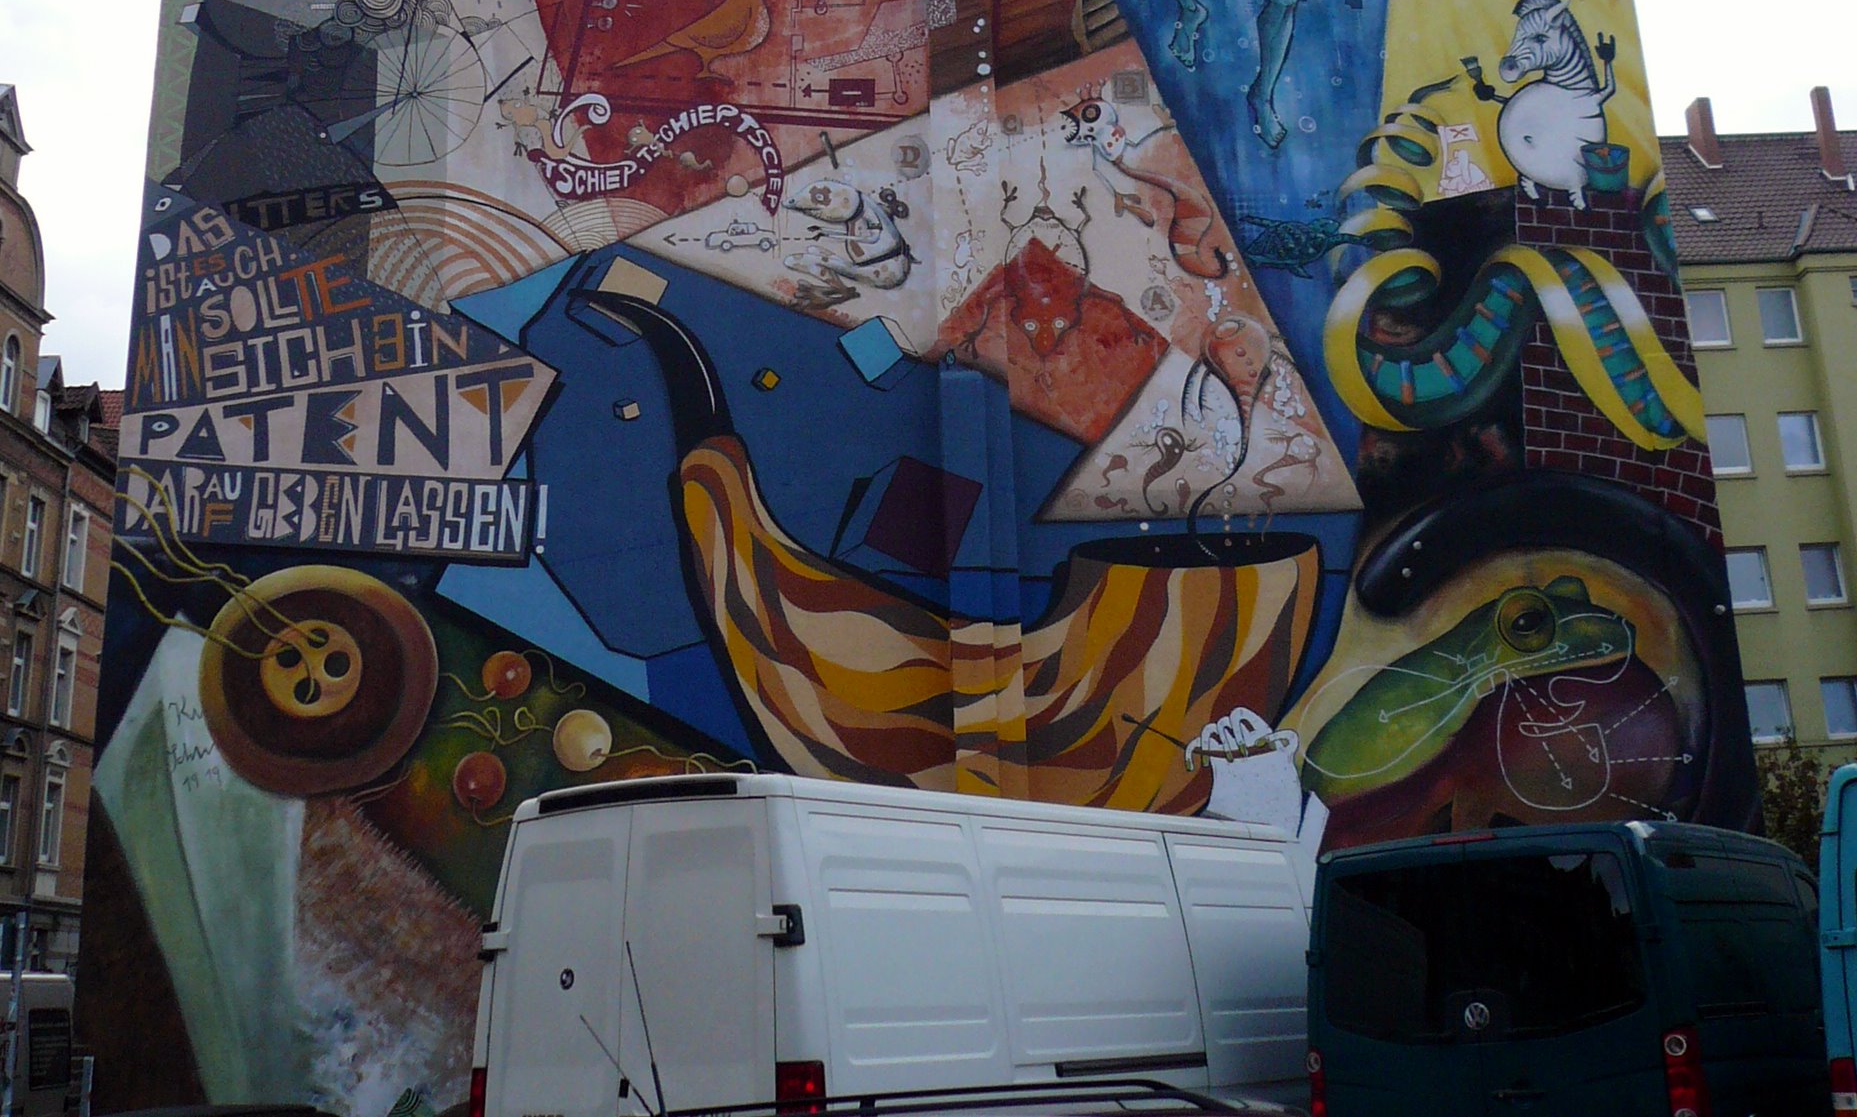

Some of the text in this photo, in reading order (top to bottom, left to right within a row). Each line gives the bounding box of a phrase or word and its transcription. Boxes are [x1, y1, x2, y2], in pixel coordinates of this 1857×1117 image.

[898, 145, 921, 169] D
[148, 206, 236, 262] DAS
[131, 253, 373, 408] MAN SOLLTE
[203, 318, 367, 390] SICH
[139, 364, 535, 472] PATENT
